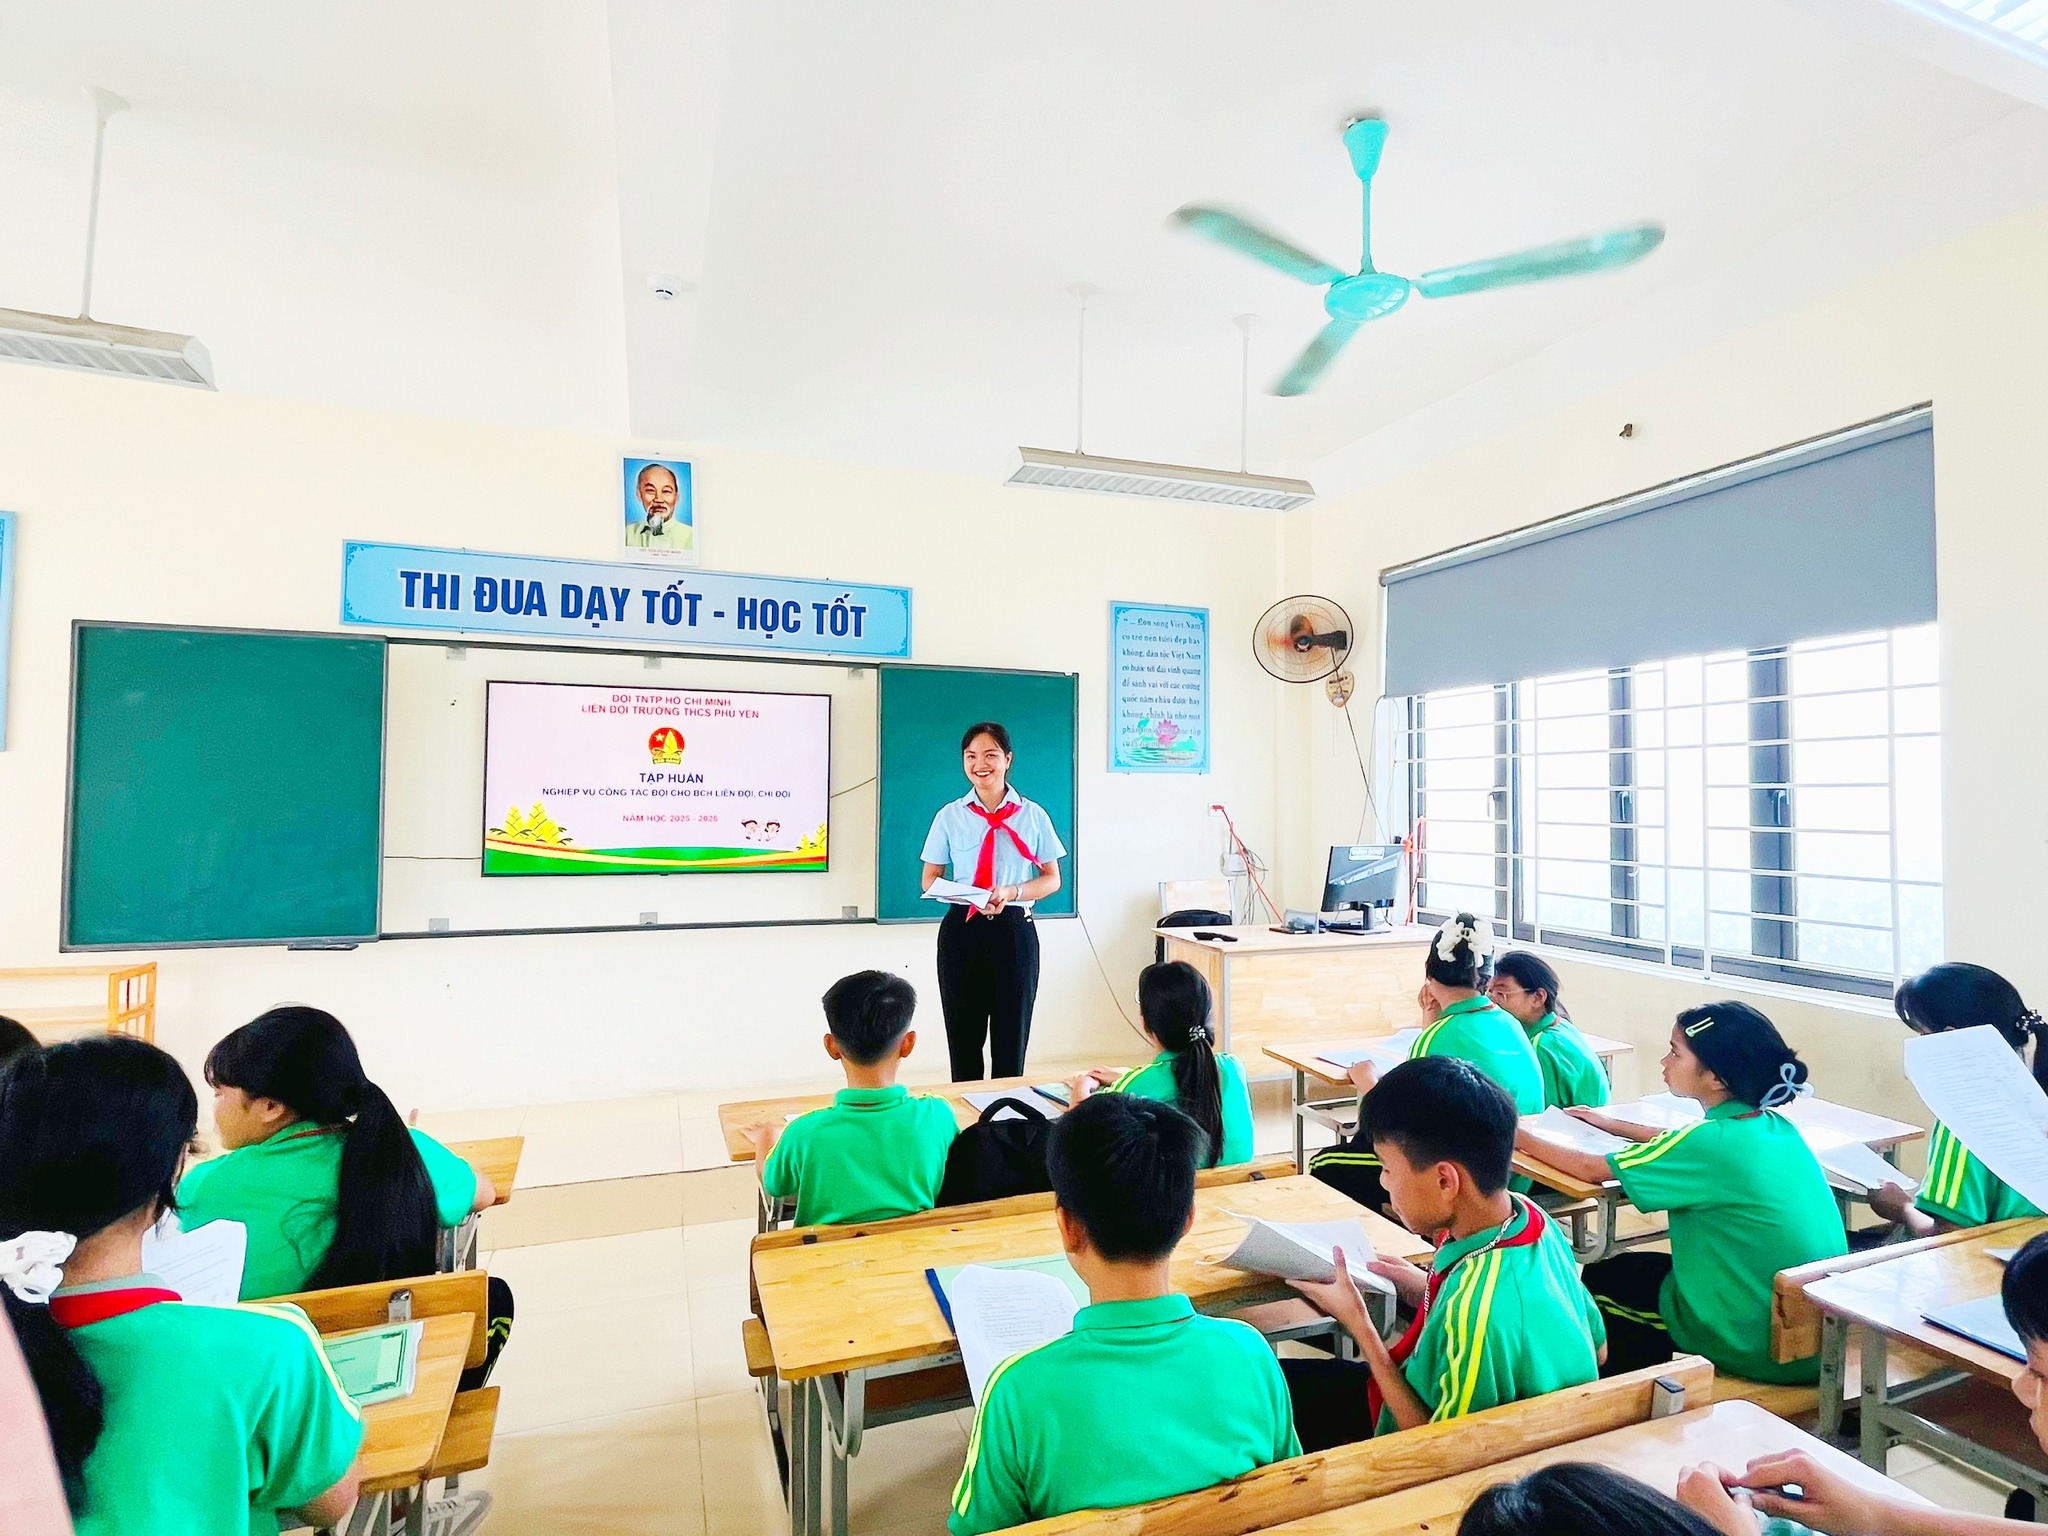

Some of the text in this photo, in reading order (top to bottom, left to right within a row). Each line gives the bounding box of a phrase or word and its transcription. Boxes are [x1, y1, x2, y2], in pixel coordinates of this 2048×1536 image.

[400, 571, 460, 610] THI
[473, 576, 547, 617] ĐUA
[561, 583, 631, 628] DẠY
[642, 580, 702, 627] TỐT
[737, 597, 800, 639] HỌC
[812, 594, 866, 638] TỐT
[635, 695, 662, 704] TNTP
[705, 698, 731, 706] MINH
[684, 707, 711, 717] THCS
[670, 789, 691, 797] CHO
[693, 789, 713, 797] BCH
